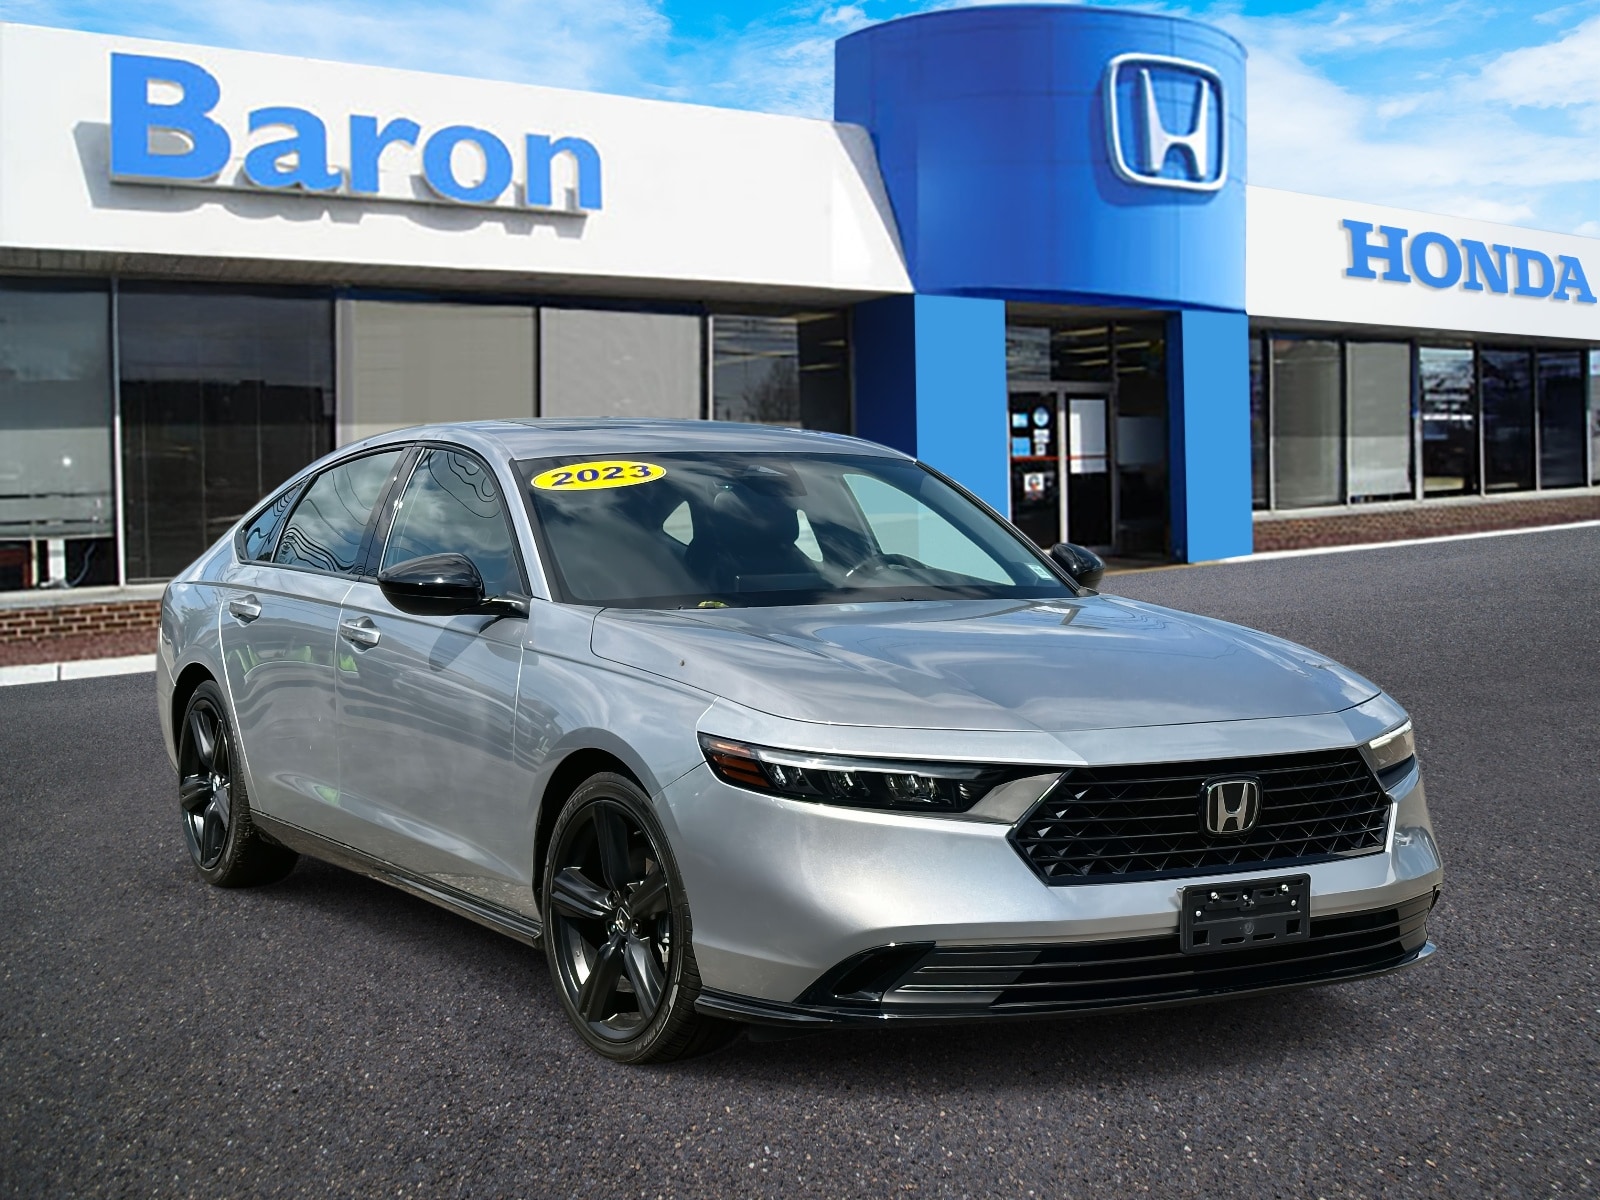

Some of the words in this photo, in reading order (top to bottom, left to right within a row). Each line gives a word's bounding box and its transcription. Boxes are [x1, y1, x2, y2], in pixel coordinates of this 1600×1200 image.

[110, 52, 603, 210] Baron
[1342, 218, 1598, 304] HONDA
[551, 464, 652, 487] 2023
